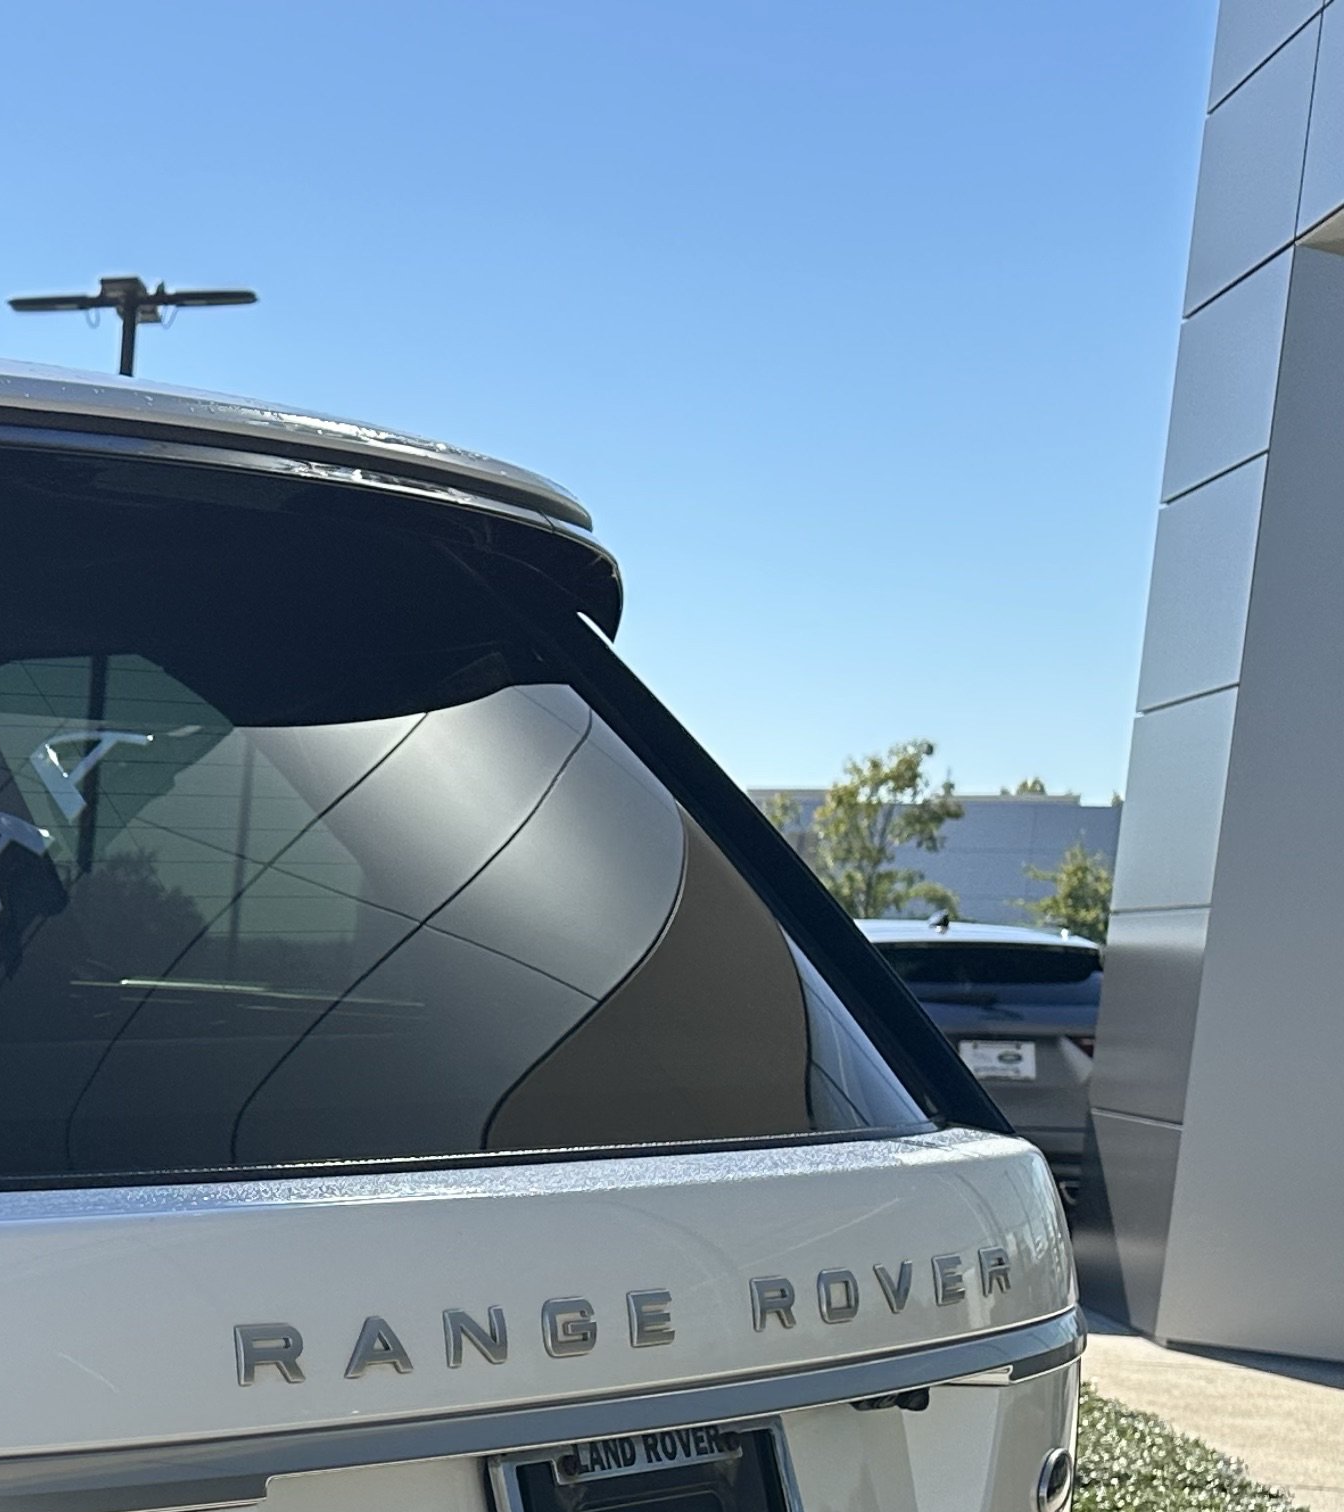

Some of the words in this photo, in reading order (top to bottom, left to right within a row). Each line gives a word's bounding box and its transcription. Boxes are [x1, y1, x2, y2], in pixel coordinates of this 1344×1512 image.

[233, 1288, 676, 1387] RANGE
[749, 1246, 1013, 1333] ROVER
[573, 1437, 637, 1474] LAND
